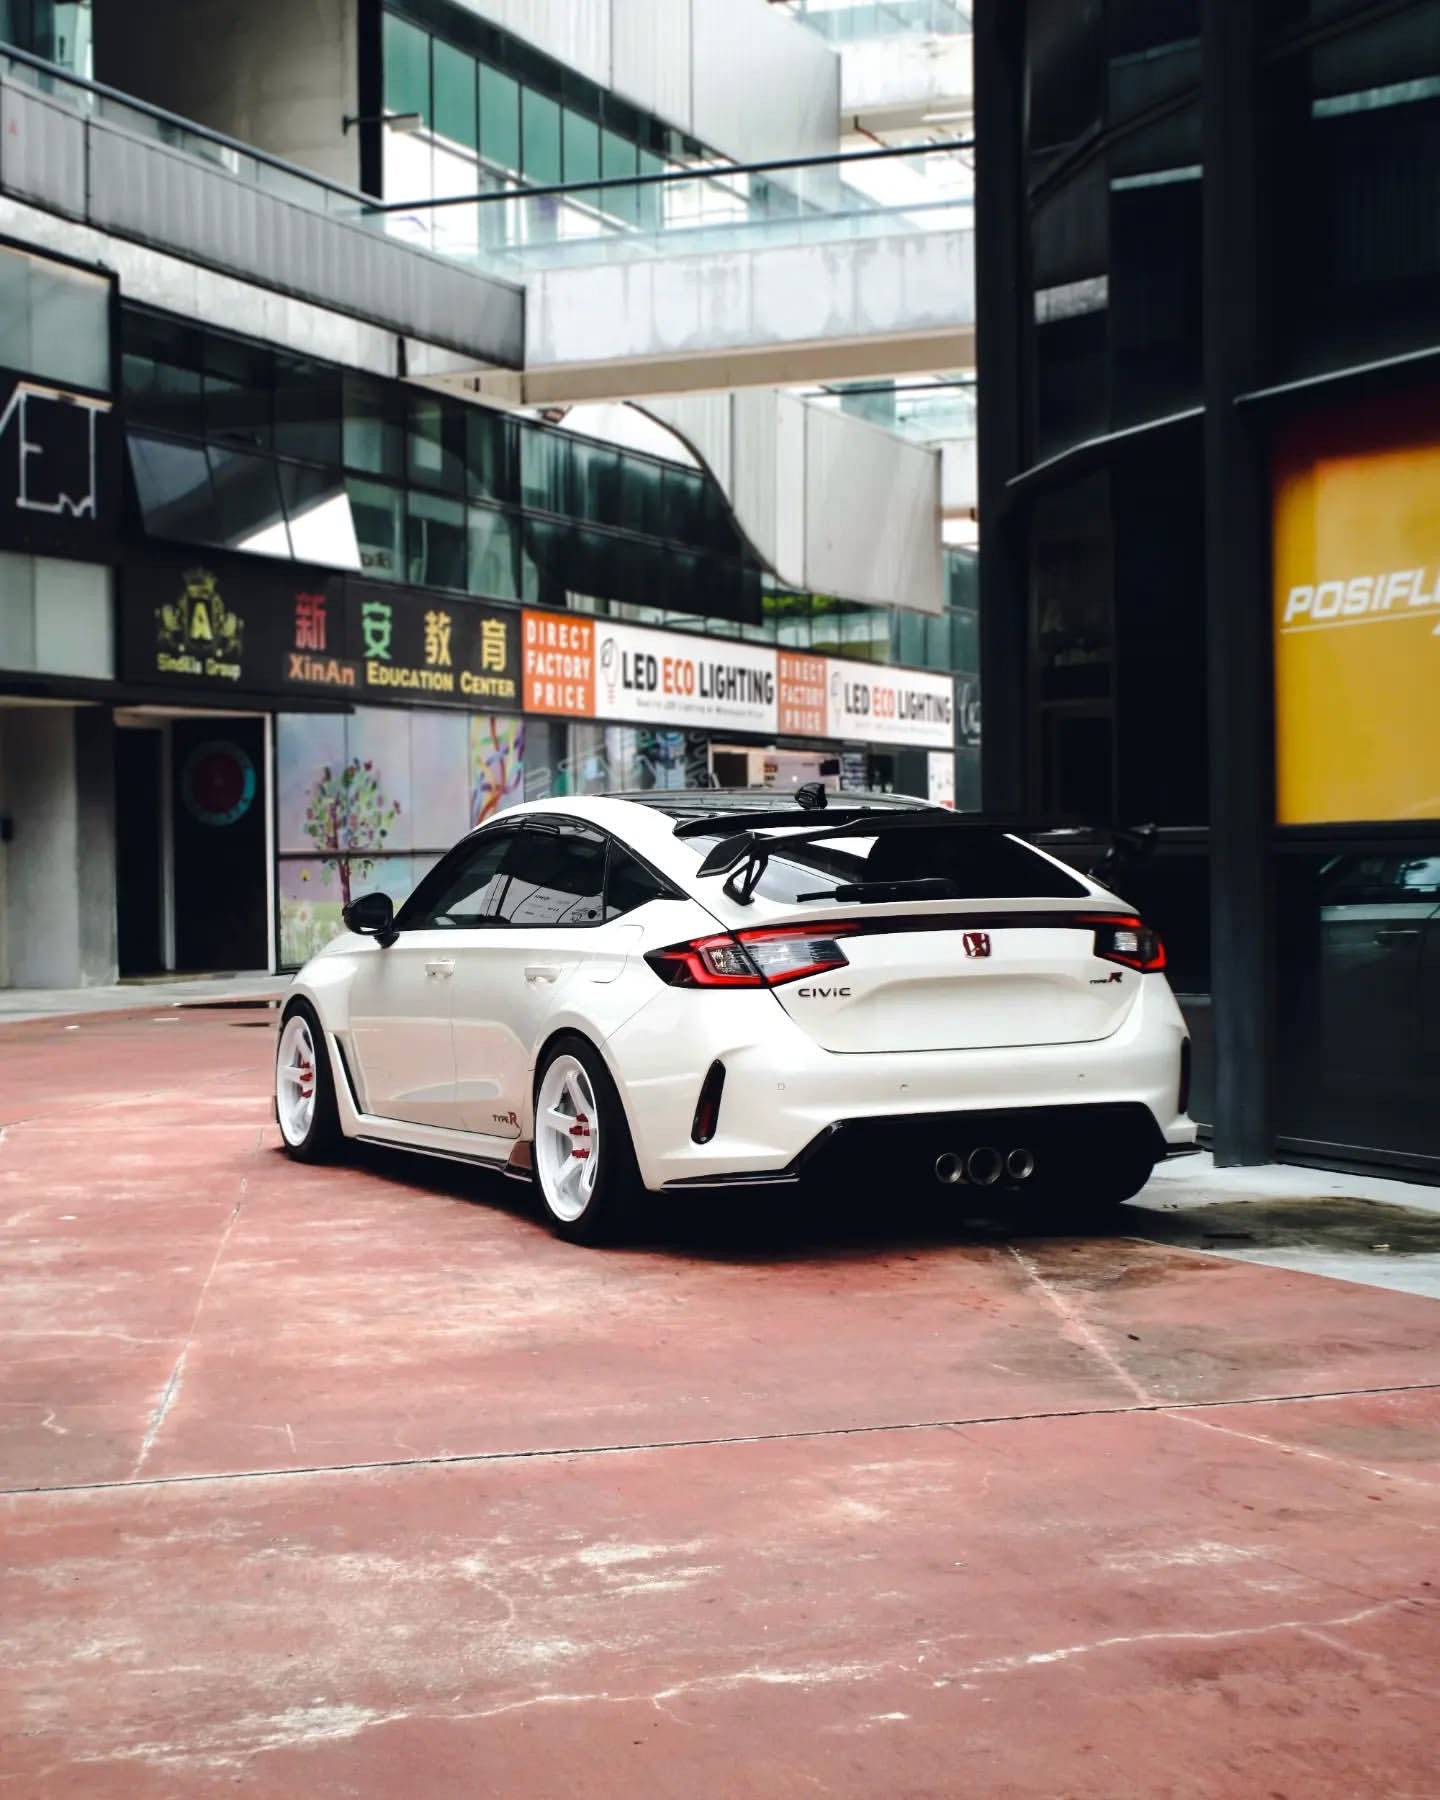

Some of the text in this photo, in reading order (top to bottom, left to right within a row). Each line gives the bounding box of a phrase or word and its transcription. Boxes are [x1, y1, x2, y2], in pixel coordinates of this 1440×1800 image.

[527, 618, 591, 652] DIRECT
[288, 652, 355, 687] XinAn
[527, 649, 592, 681] FACTORY
[622, 651, 774, 706] LED ECO LIGHTING
[533, 681, 585, 711] PRICE
[844, 681, 870, 715] LED
[872, 686, 896, 718] ECO
[897, 690, 950, 725] LIGHTING
[797, 986, 852, 998] CIVIC
